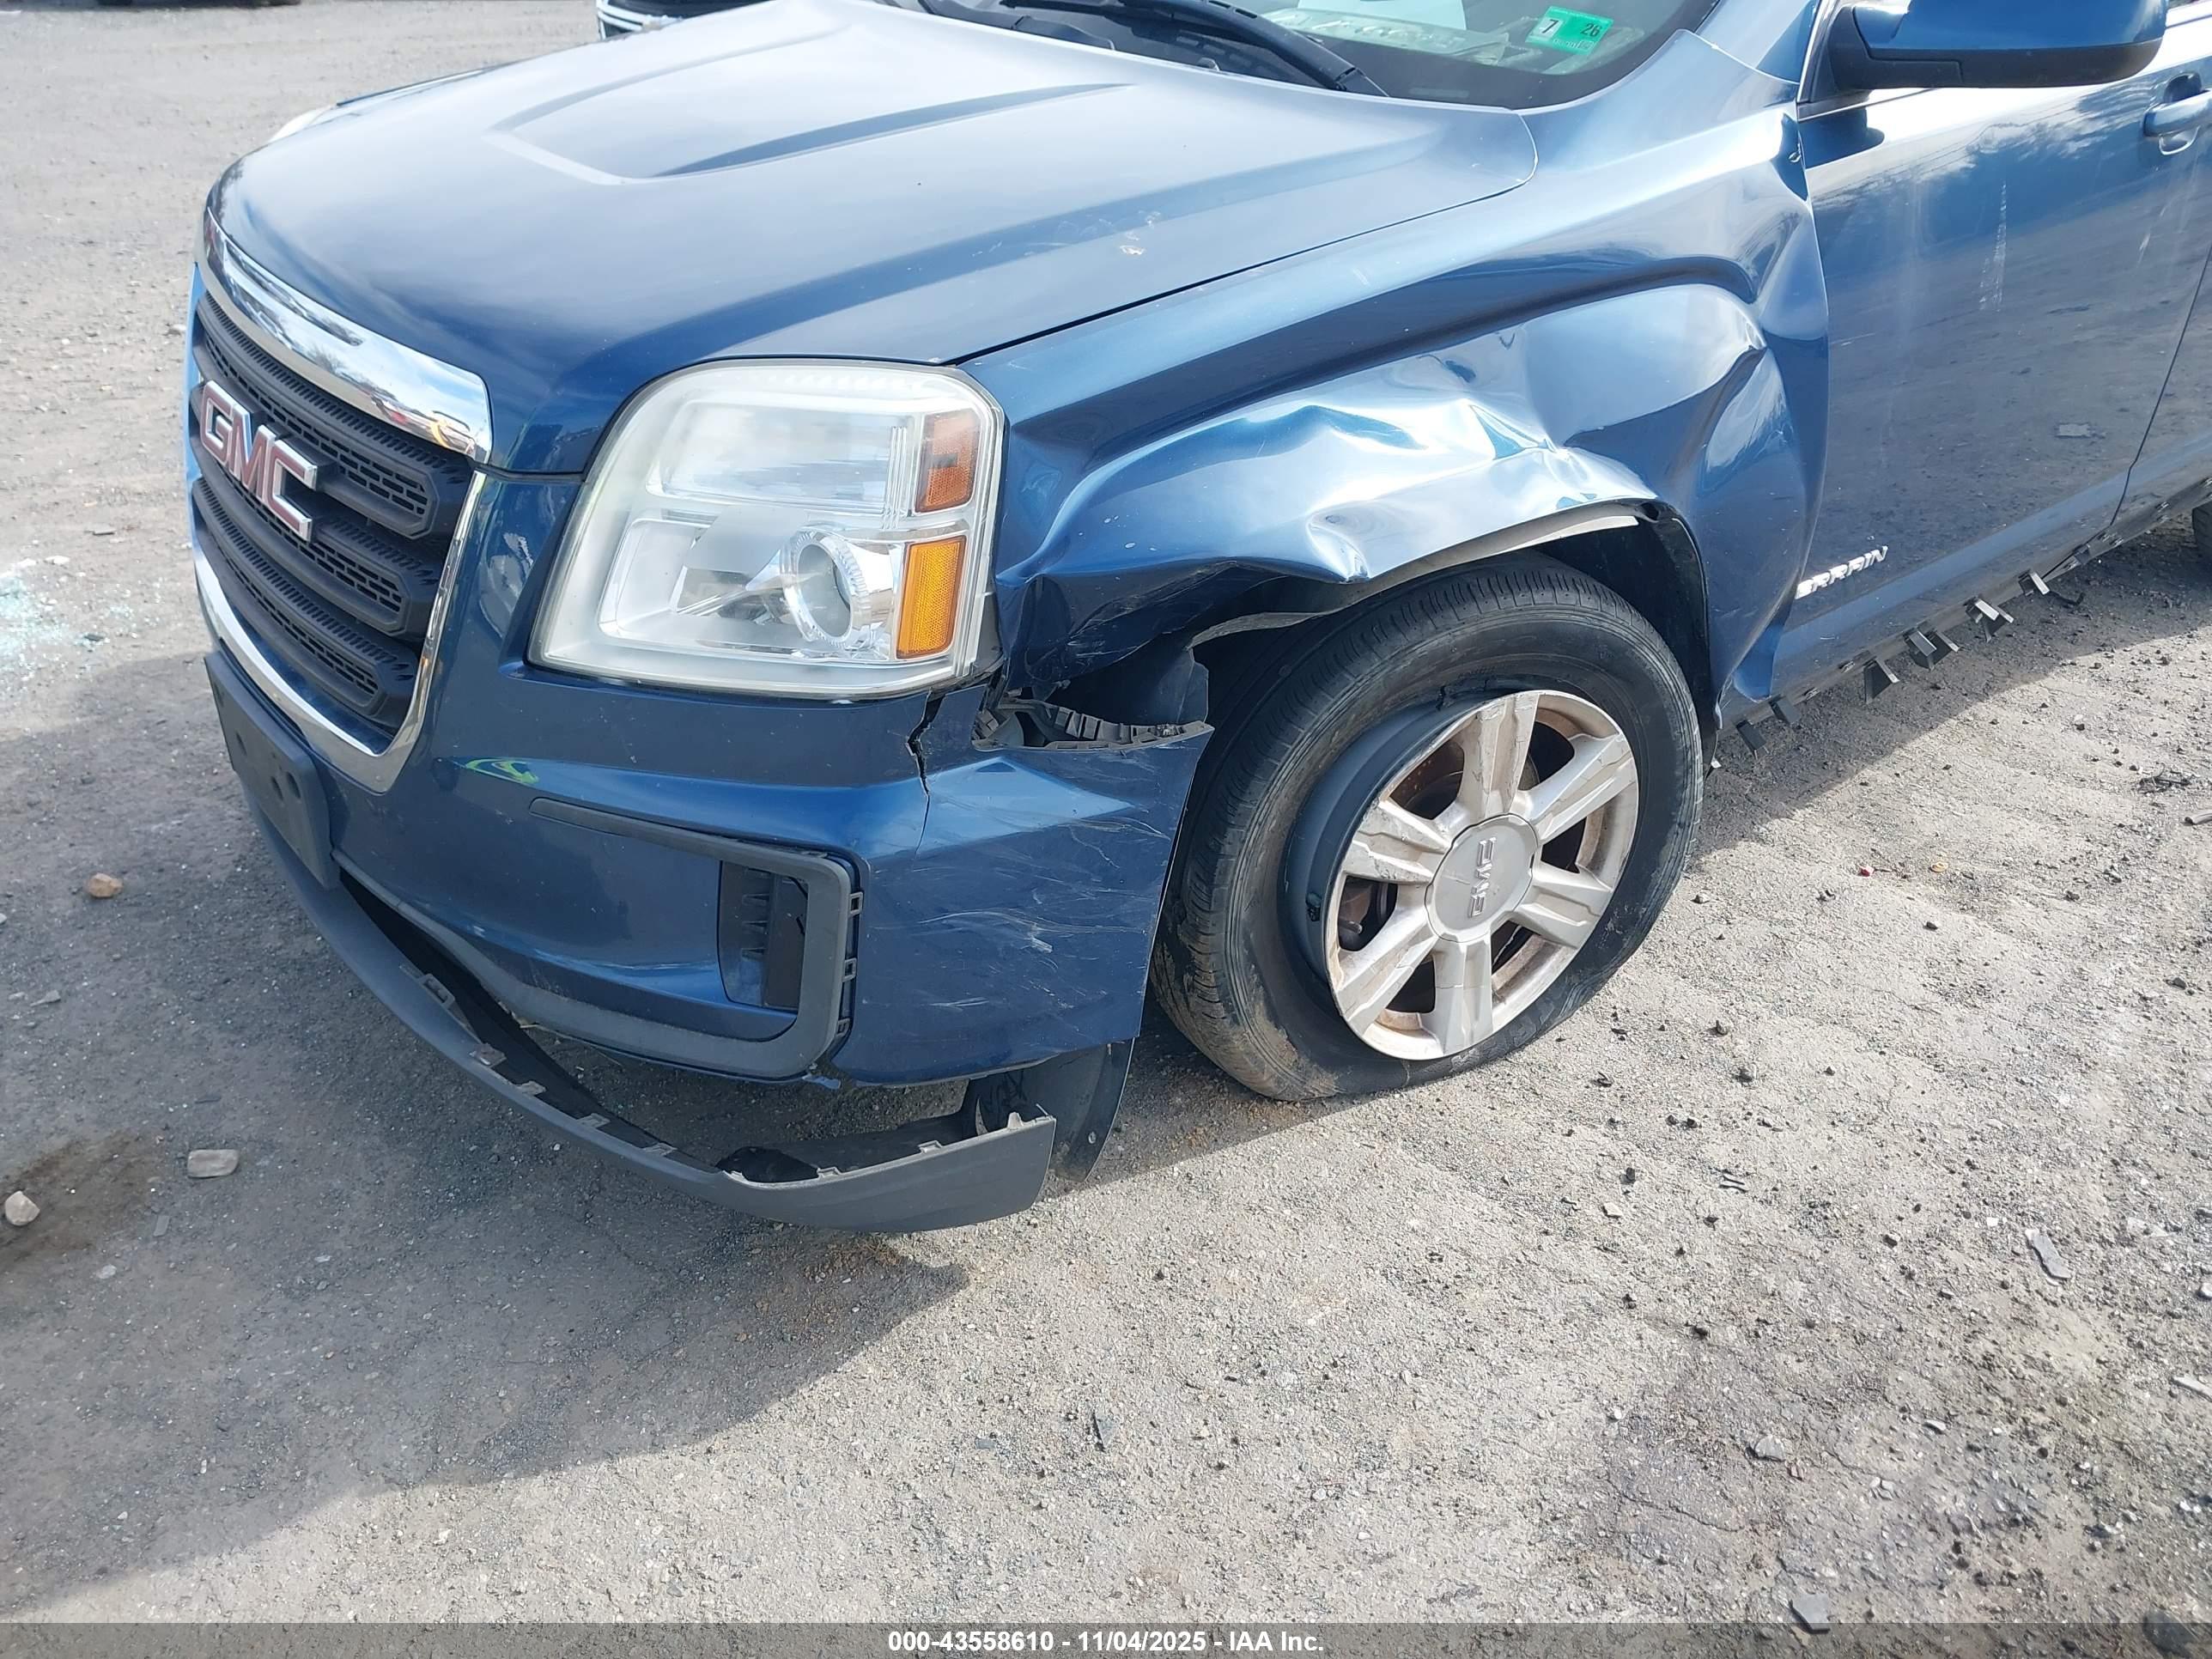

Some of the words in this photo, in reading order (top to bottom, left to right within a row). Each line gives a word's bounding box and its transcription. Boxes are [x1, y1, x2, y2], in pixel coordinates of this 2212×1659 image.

[1542, 19, 1559, 33] 7
[1580, 23, 1602, 37] 26
[200, 380, 318, 543] GMC
[1469, 837, 1497, 917] GMC
